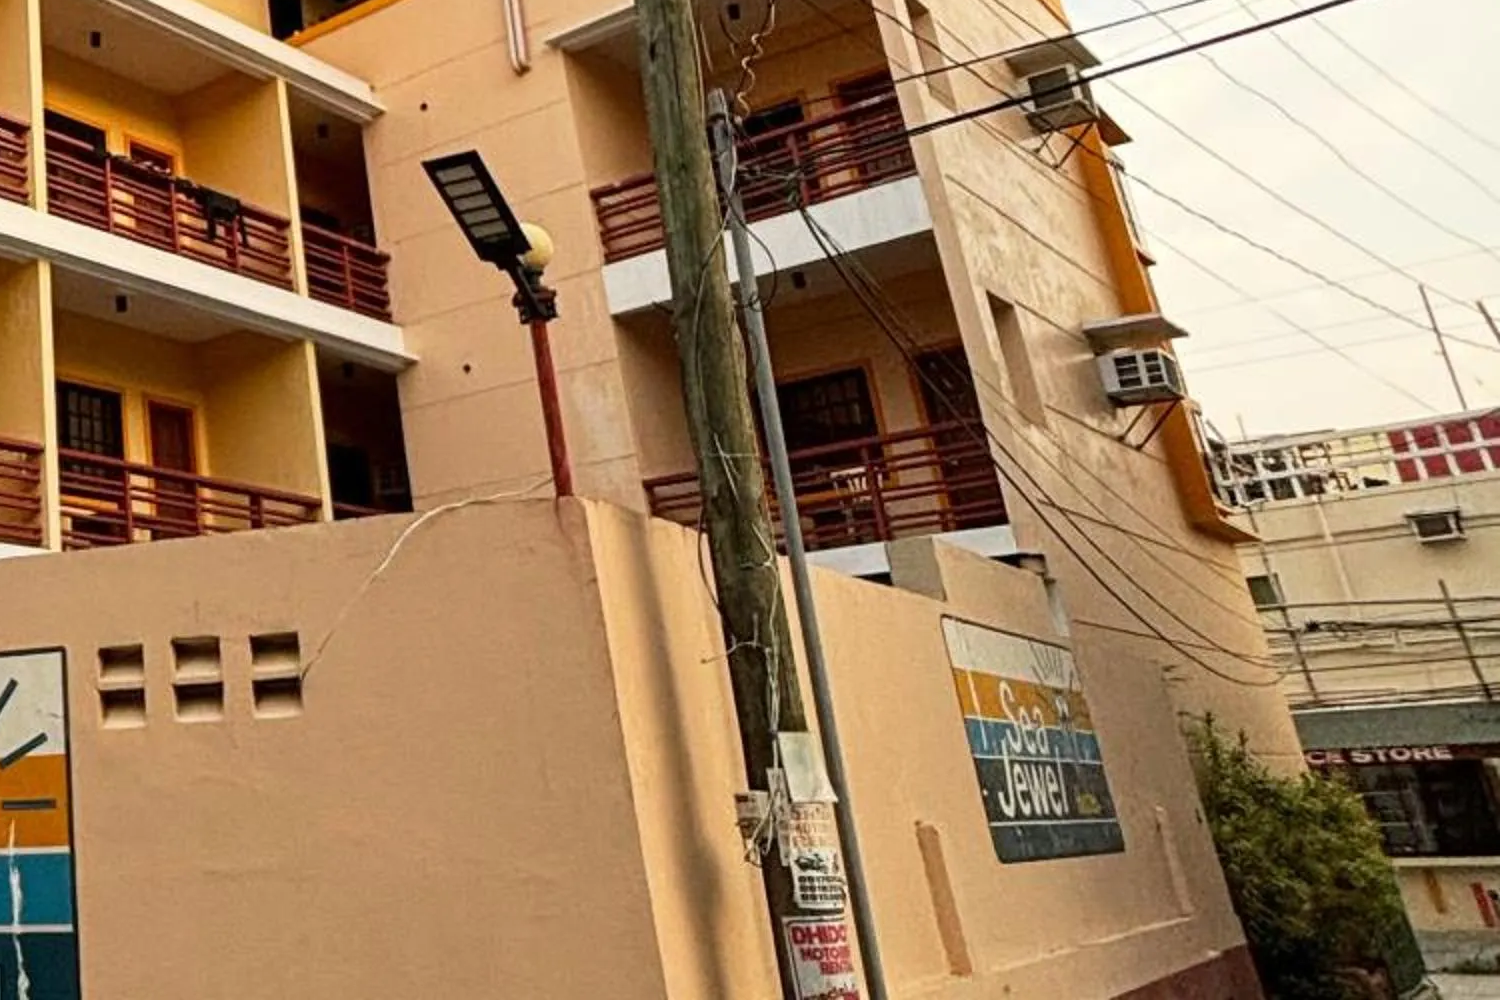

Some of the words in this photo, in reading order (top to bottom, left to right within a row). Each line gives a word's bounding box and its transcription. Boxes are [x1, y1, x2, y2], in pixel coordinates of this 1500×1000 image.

[999, 679, 1050, 755] Sea
[1351, 745, 1454, 764] STORE
[998, 738, 1070, 819] Jewel
